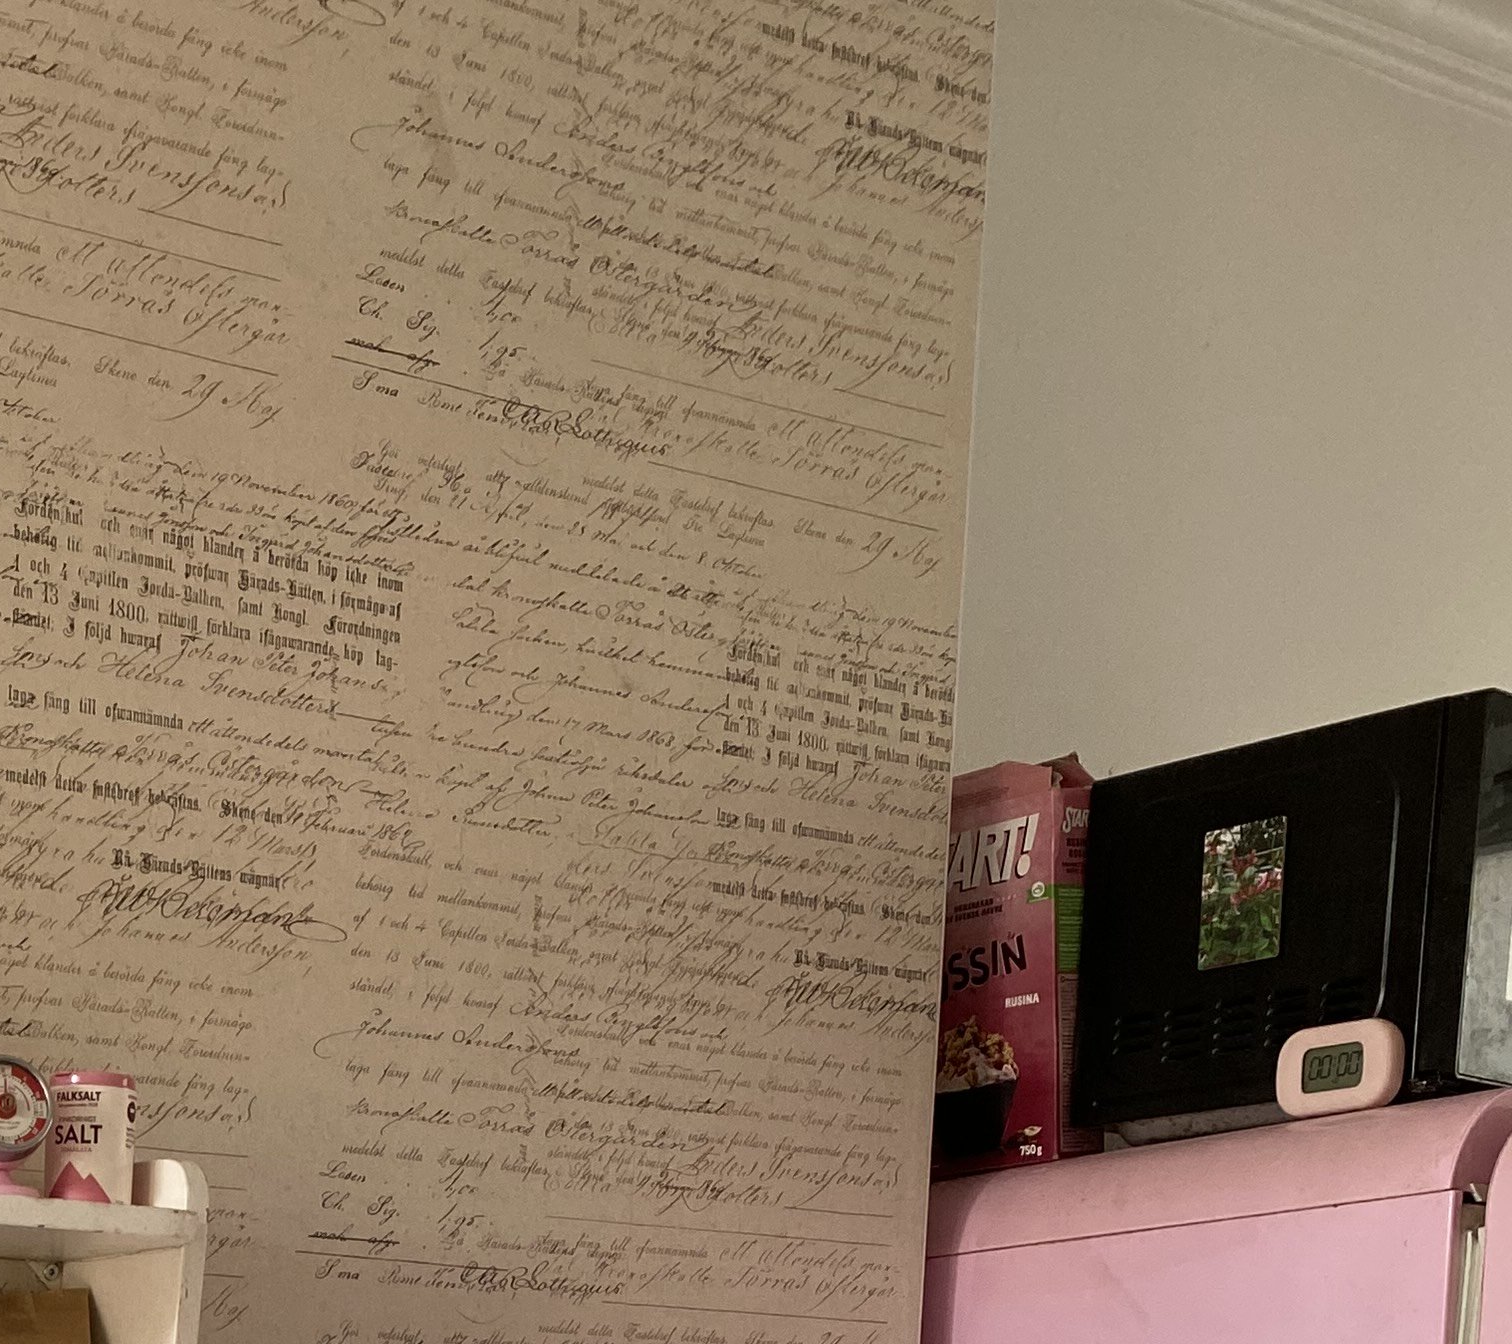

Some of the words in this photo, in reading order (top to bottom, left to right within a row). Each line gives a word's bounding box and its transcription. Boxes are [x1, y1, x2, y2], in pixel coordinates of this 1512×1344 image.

[948, 813, 1040, 893] ART!
[947, 933, 1028, 991] SSIN
[1005, 993, 1040, 1009] RUSINA
[56, 1091, 102, 1102] FALKSALT
[54, 1124, 103, 1145] SALT
